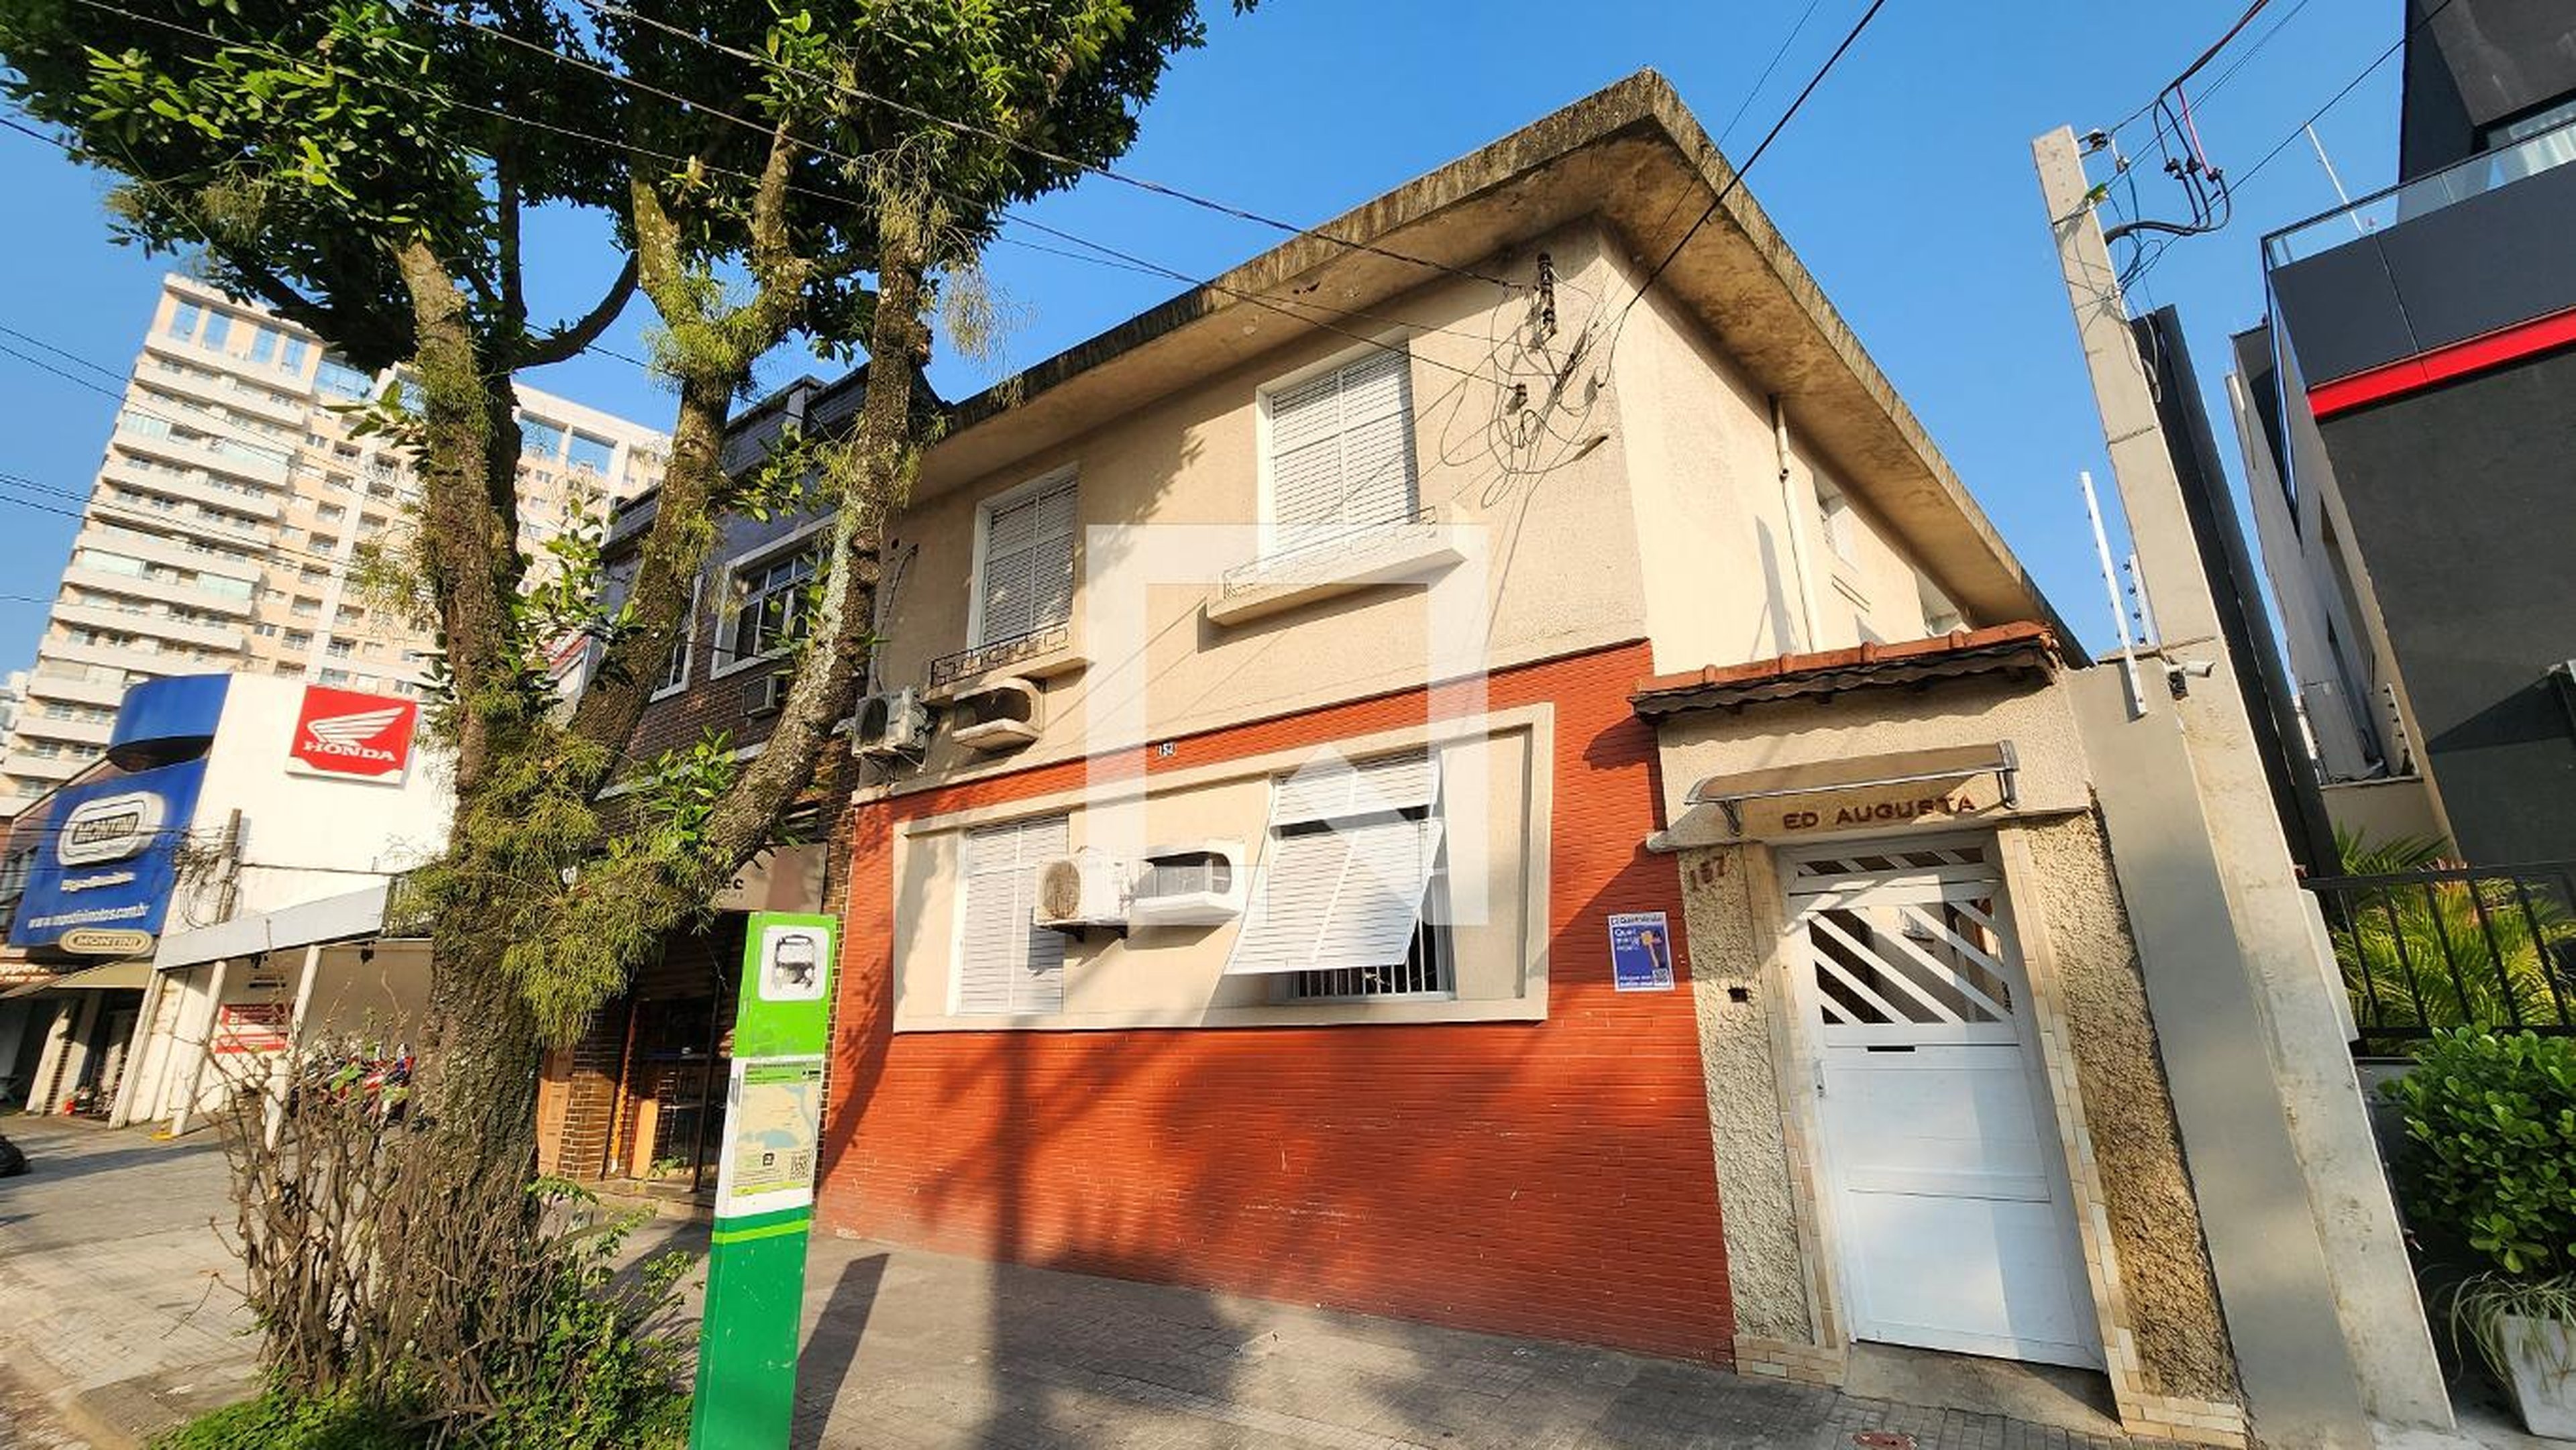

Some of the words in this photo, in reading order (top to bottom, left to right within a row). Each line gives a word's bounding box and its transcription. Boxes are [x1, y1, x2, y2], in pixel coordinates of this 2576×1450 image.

[303, 741, 396, 761] HONDA
[1782, 812, 1819, 830] ED
[1835, 794, 1976, 826] AUGUSTA
[74, 816, 138, 844] MONTINI
[75, 936, 140, 947] MONTINI
